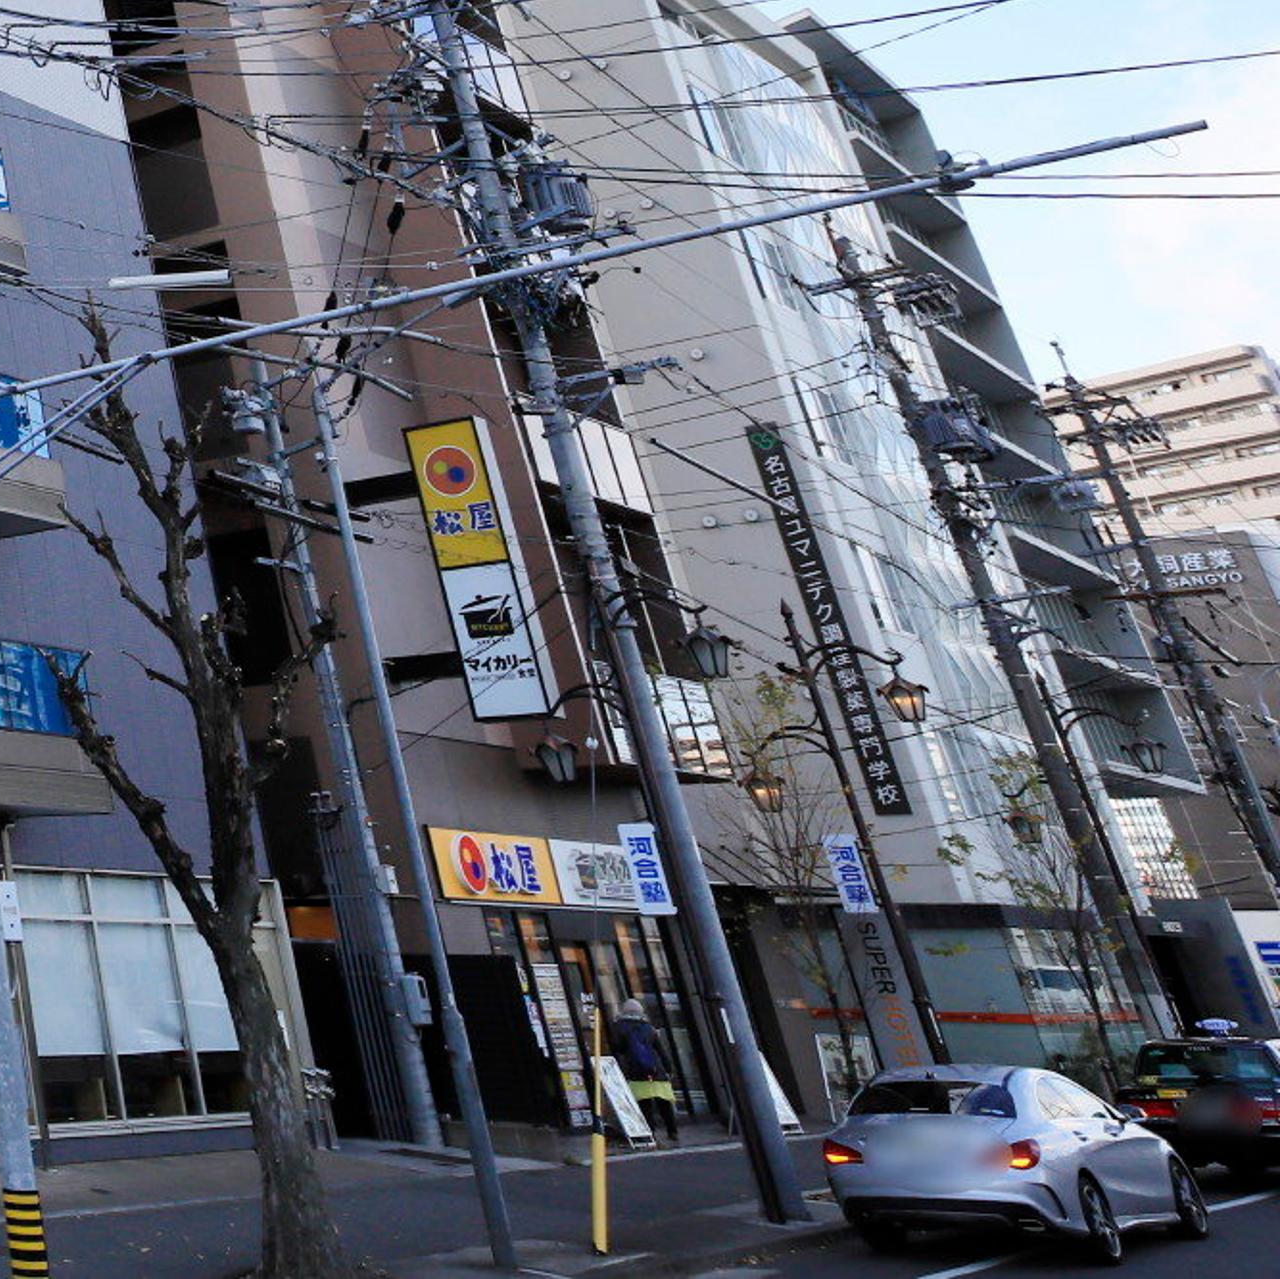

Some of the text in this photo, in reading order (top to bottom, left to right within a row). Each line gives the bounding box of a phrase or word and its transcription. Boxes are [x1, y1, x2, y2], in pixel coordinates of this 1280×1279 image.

[433, 501, 496, 534] 松屋
[1165, 570, 1243, 588] SANGYO
[464, 654, 533, 672] マイカリー
[490, 842, 542, 892] 松屋
[858, 922, 897, 995] SUPER
